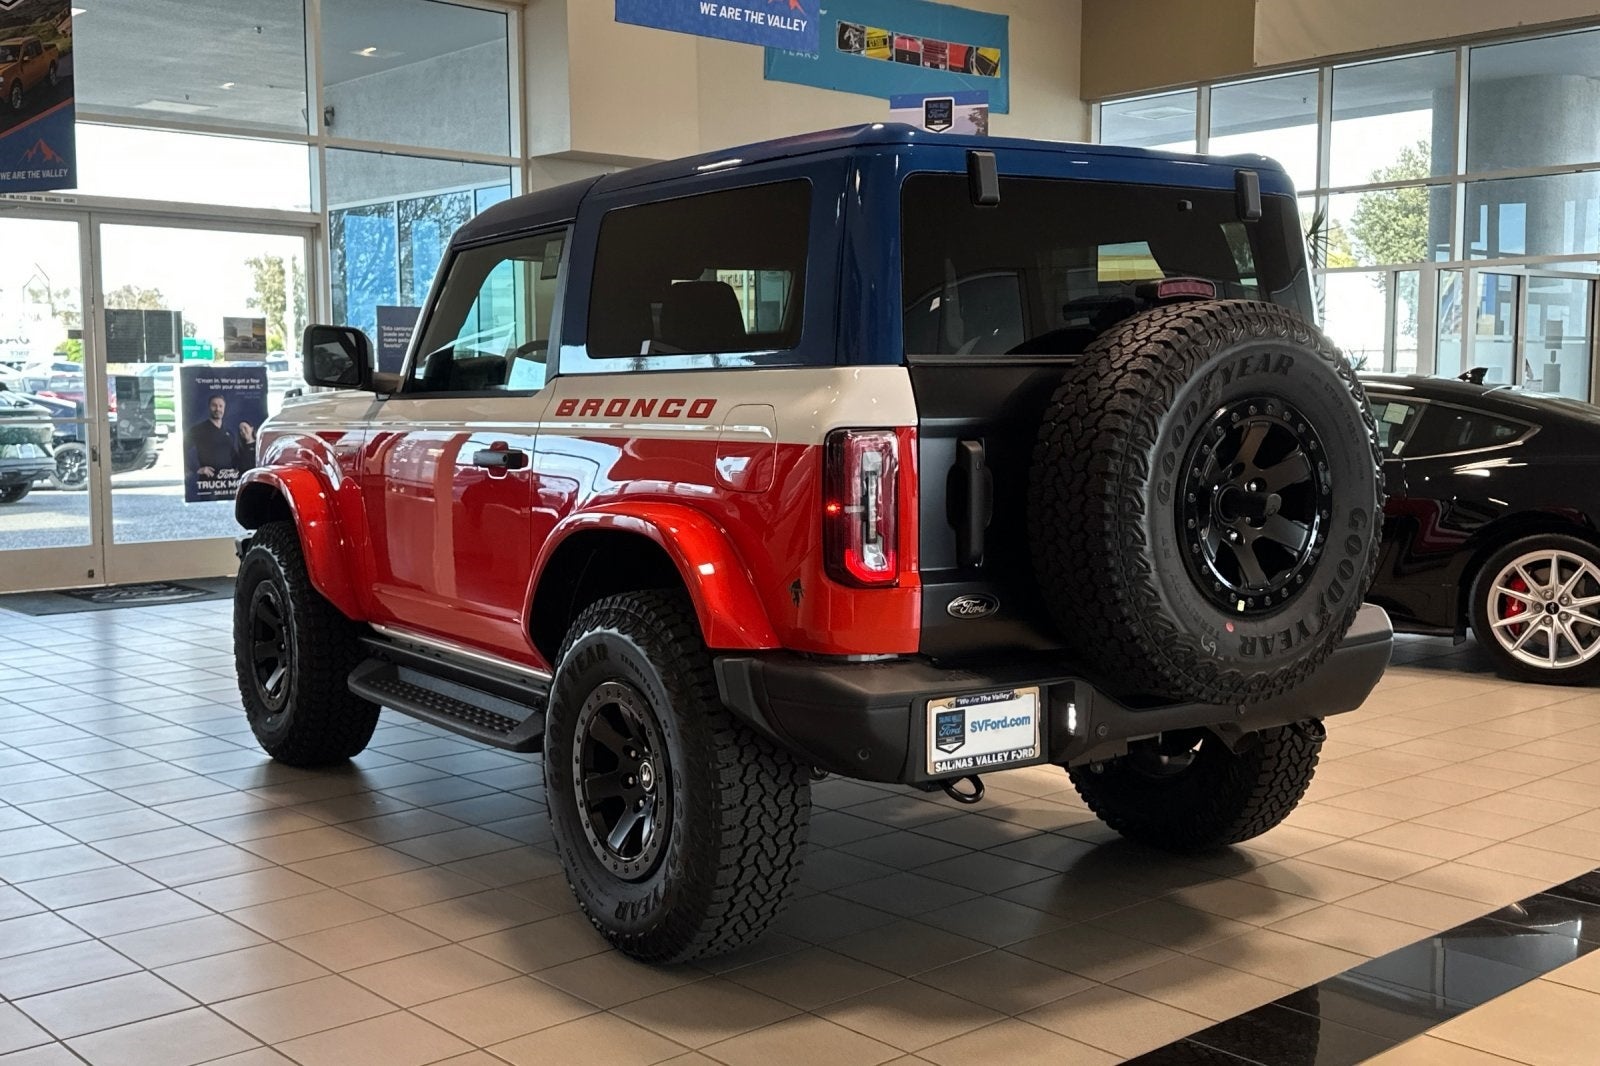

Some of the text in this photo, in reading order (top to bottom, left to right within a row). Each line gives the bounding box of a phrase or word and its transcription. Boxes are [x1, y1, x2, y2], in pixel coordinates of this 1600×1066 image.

[700, 2, 808, 33] WE ARE THE VALLEY
[11, 170, 26, 179] ARE
[27, 169, 41, 179] THE
[41, 168, 69, 178] VALLEY
[555, 398, 718, 418] BRONCO
[217, 468, 240, 479] Ford
[196, 480, 227, 490] TRUCK
[960, 599, 987, 614] Ford
[939, 723, 962, 736] Ford
[970, 715, 1031, 733] SVFord.com
[935, 748, 1034, 772] SALINAS VALLEY FORD
